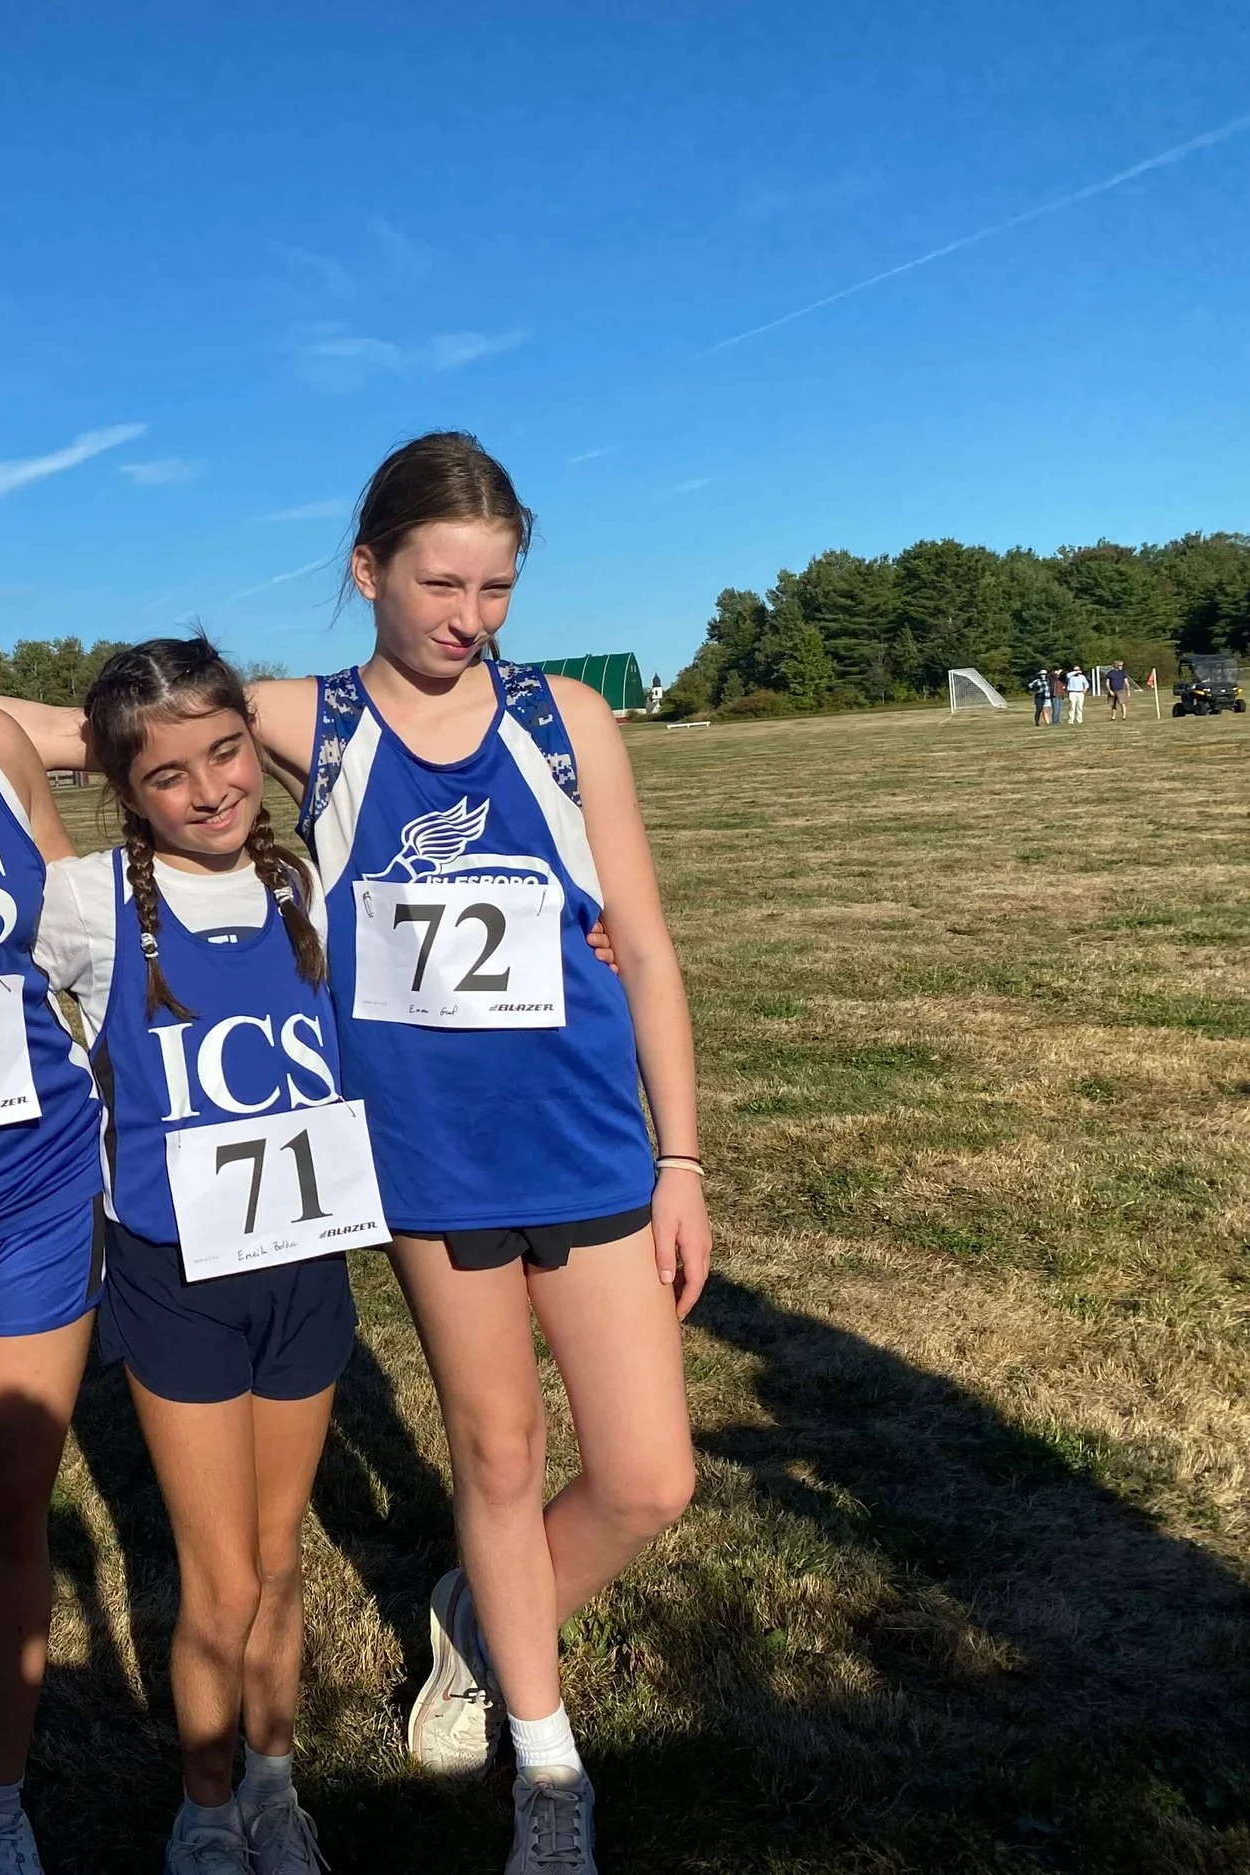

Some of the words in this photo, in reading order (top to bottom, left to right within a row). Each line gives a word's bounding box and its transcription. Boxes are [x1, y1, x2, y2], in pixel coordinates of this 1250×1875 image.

[393, 902, 511, 992] 72
[497, 1003, 554, 1012] BLAZER
[148, 1013, 339, 1121] ICS
[215, 1129, 333, 1235] 71
[326, 1221, 377, 1238] BLAZER
